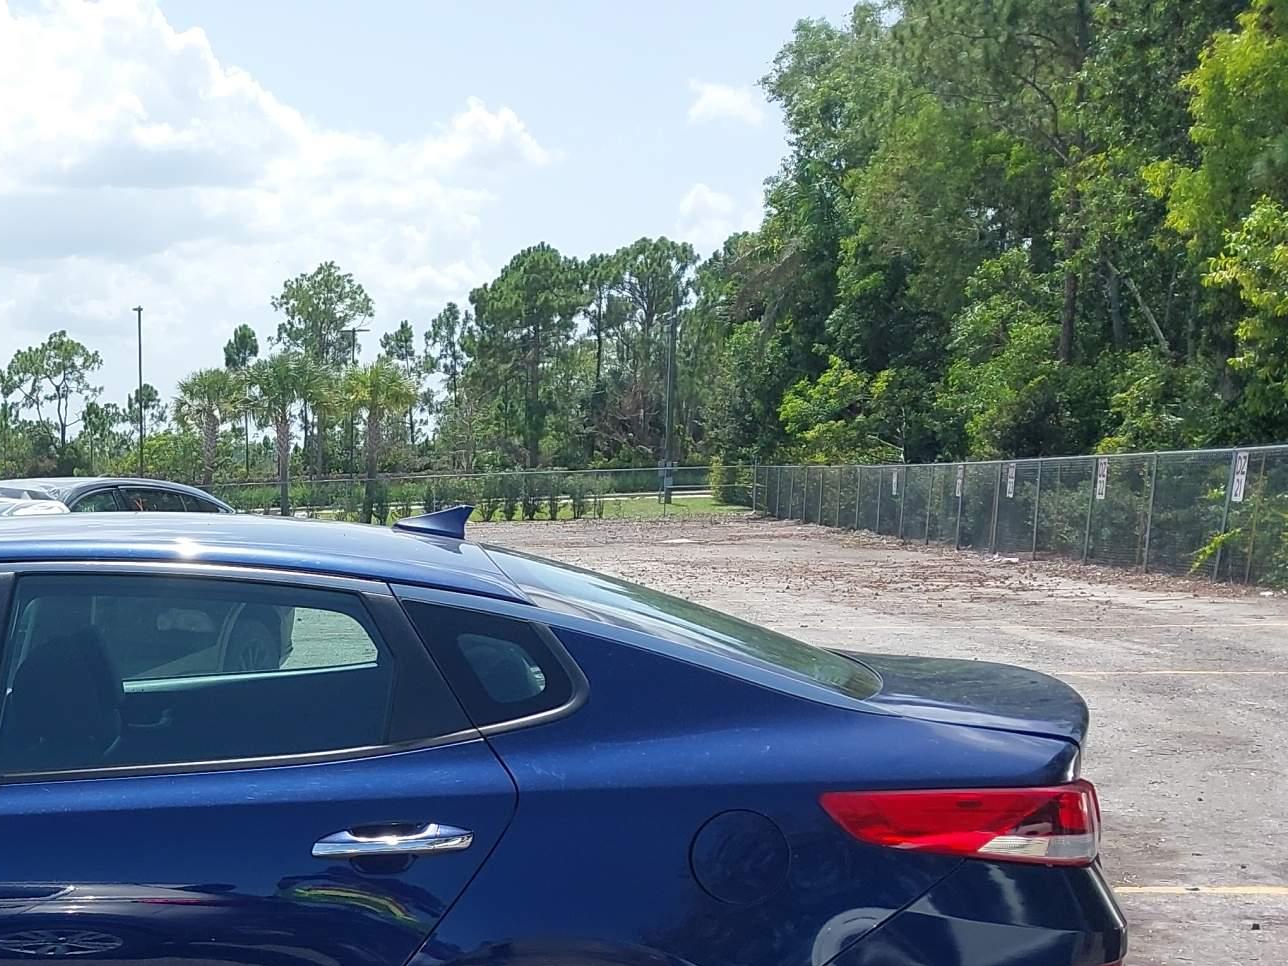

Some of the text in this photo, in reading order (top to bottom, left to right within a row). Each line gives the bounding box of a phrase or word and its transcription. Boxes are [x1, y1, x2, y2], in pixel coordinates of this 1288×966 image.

[1099, 461, 1106, 478] DZ
[1236, 455, 1247, 475] DZ
[1098, 479, 1105, 496] 22
[1234, 478, 1242, 497] 21
